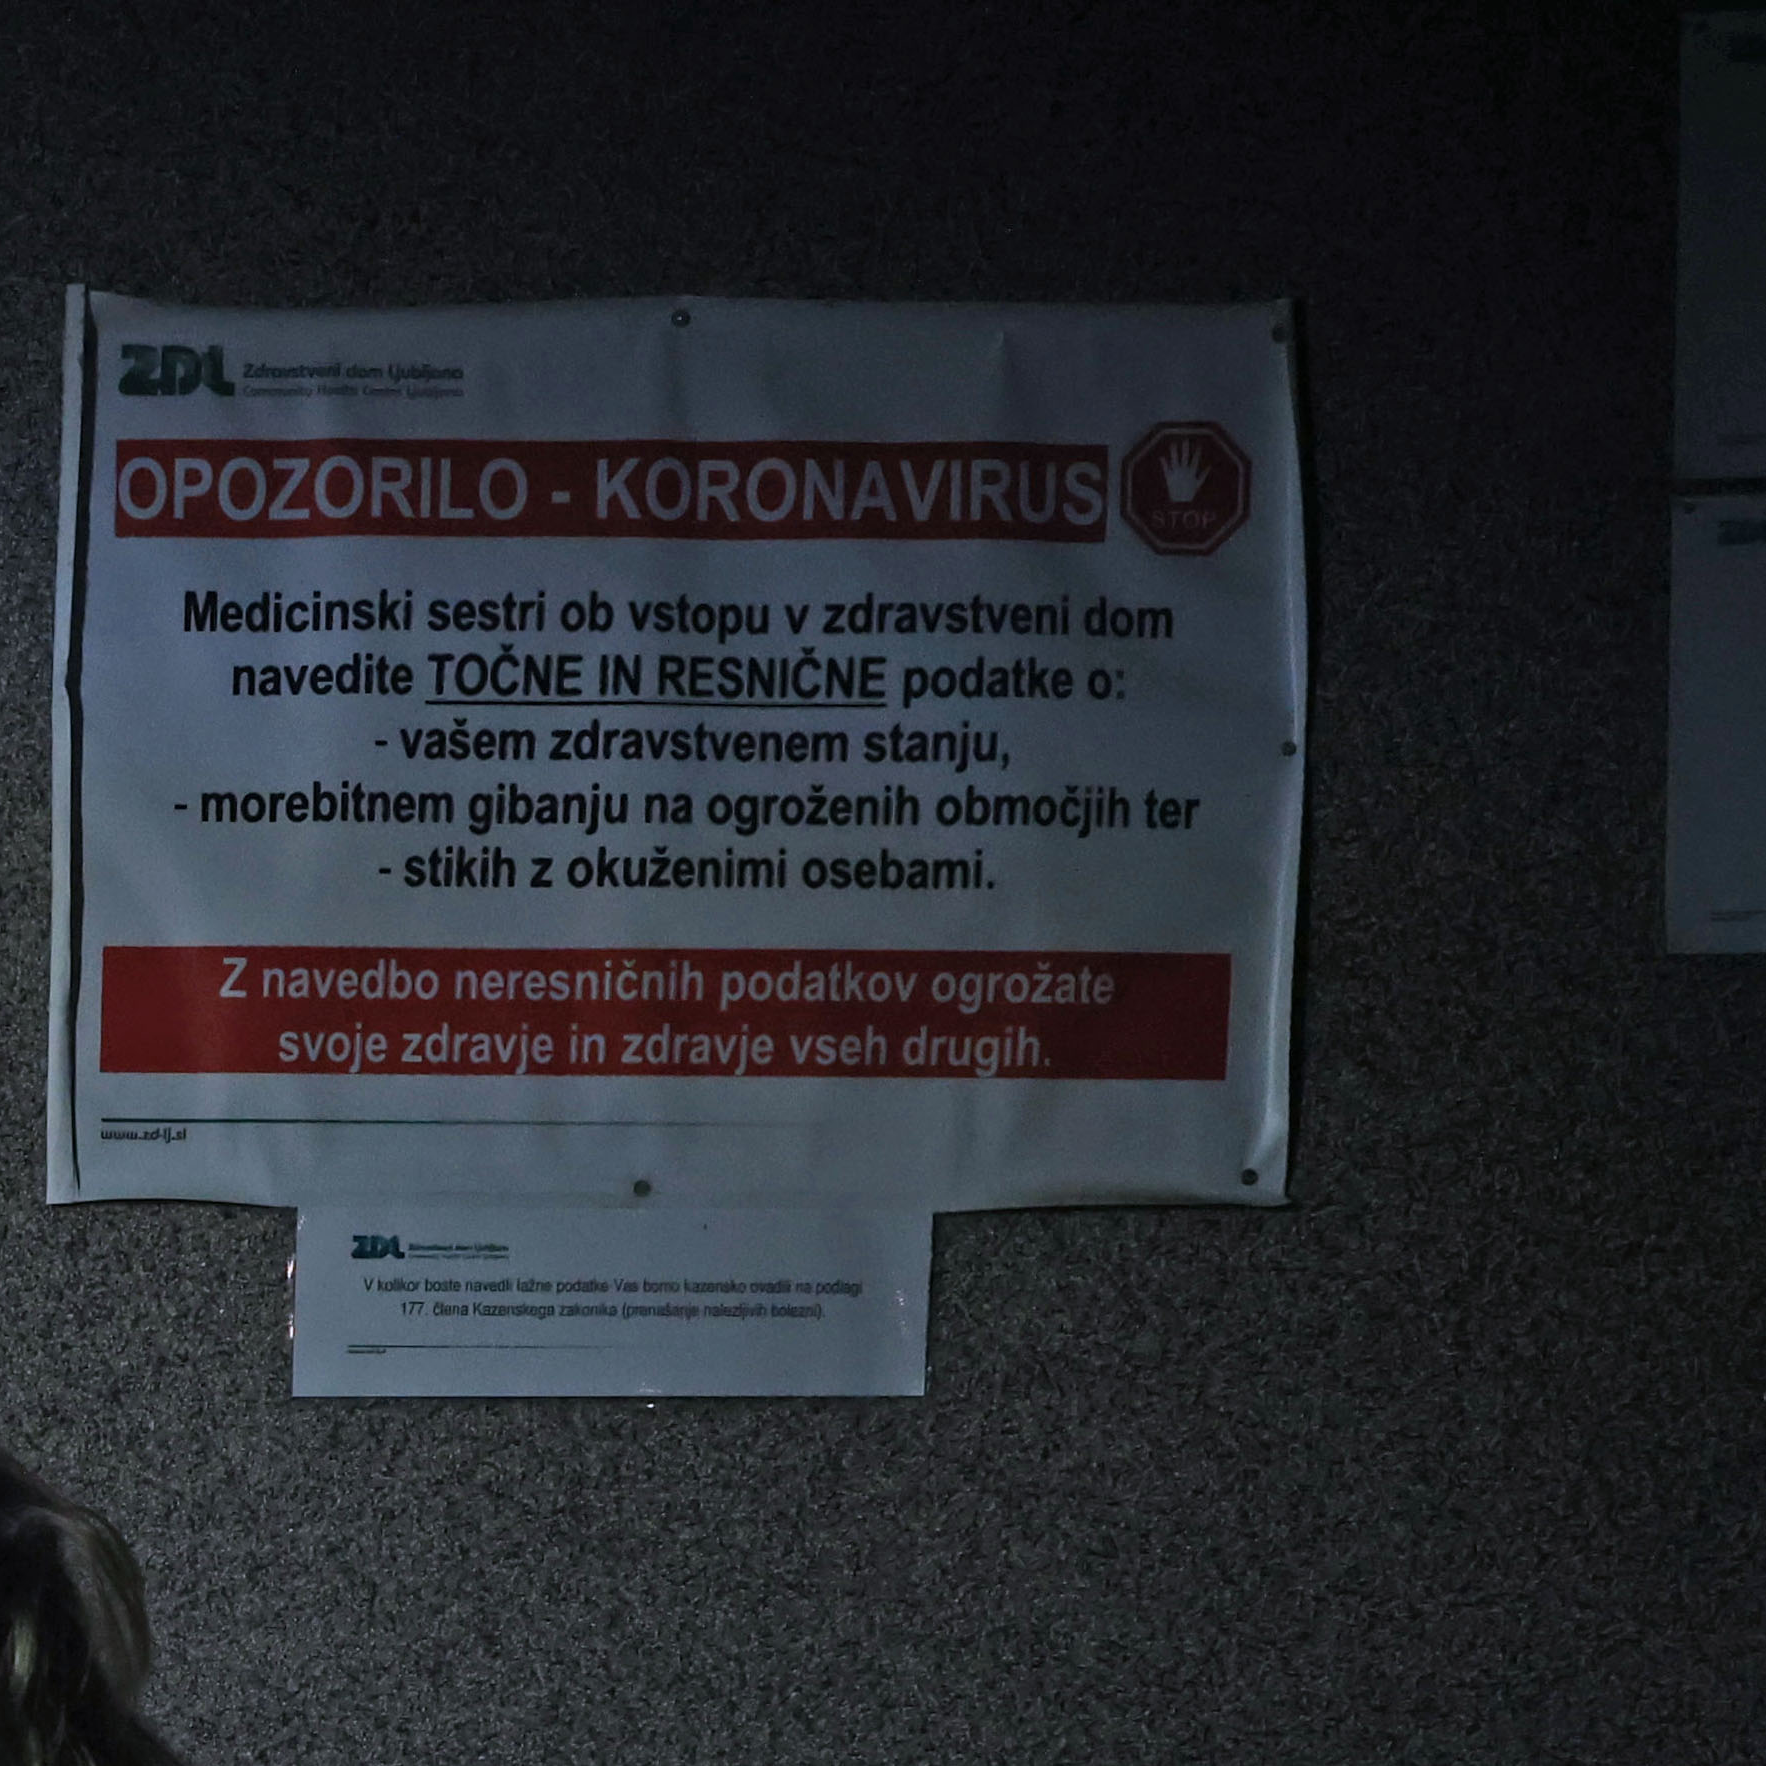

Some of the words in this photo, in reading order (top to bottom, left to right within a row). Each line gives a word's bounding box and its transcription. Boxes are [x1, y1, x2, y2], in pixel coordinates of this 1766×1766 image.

[119, 344, 235, 397] ZDL
[243, 362, 341, 380] Zdravstveni
[346, 365, 383, 379] dom
[388, 363, 464, 384] Ljubljana
[117, 455, 529, 522] OPOZORILO
[551, 490, 570, 504] -
[594, 457, 1106, 527] KORONAVIRUS
[1151, 508, 1215, 530] STOP
[183, 590, 414, 633] Medicinski
[427, 591, 546, 632] sestri
[559, 592, 614, 632] ob
[629, 594, 769, 643] vstopu
[785, 605, 809, 633] v
[822, 592, 1070, 636] zdravstveni
[1083, 597, 1175, 639] dom
[232, 654, 414, 696] navedite
[428, 645, 584, 697] TOČNE
[599, 655, 643, 697] IN
[658, 647, 888, 700] RESNIČNE
[903, 658, 1073, 708] podatke
[1087, 669, 1127, 701] o:
[399, 719, 536, 761] vašem
[548, 719, 849, 763] zdravstvenem
[862, 722, 1011, 773] stanju,
[199, 781, 454, 823] morebitnem
[469, 783, 629, 835] gibanju
[644, 792, 694, 825] na
[706, 784, 920, 836] ogroženih
[934, 786, 1131, 839] območjih
[1144, 791, 1201, 830] ter
[403, 846, 516, 889] stikih
[530, 857, 554, 889] z
[567, 846, 788, 889] okuženimi
[800, 848, 996, 890] osebami.
[219, 956, 249, 999] Z
[261, 959, 439, 1000] navedbo
[454, 959, 705, 1001] neresničnih
[719, 961, 918, 1011] podatkov
[930, 962, 1115, 1014] ogrožate
[278, 1025, 388, 1074] svoje
[400, 1023, 555, 1075] zdravje
[570, 1026, 607, 1065] in
[620, 1024, 775, 1075] zdravje
[789, 1026, 888, 1067] vseh
[902, 1026, 1053, 1078] drugih.
[350, 1235, 405, 1259] ZDL
[363, 1277, 375, 1292] V
[377, 1277, 420, 1292] kolikor
[424, 1277, 461, 1292] boste
[556, 1277, 609, 1297] podatke
[795, 1281, 813, 1295] na
